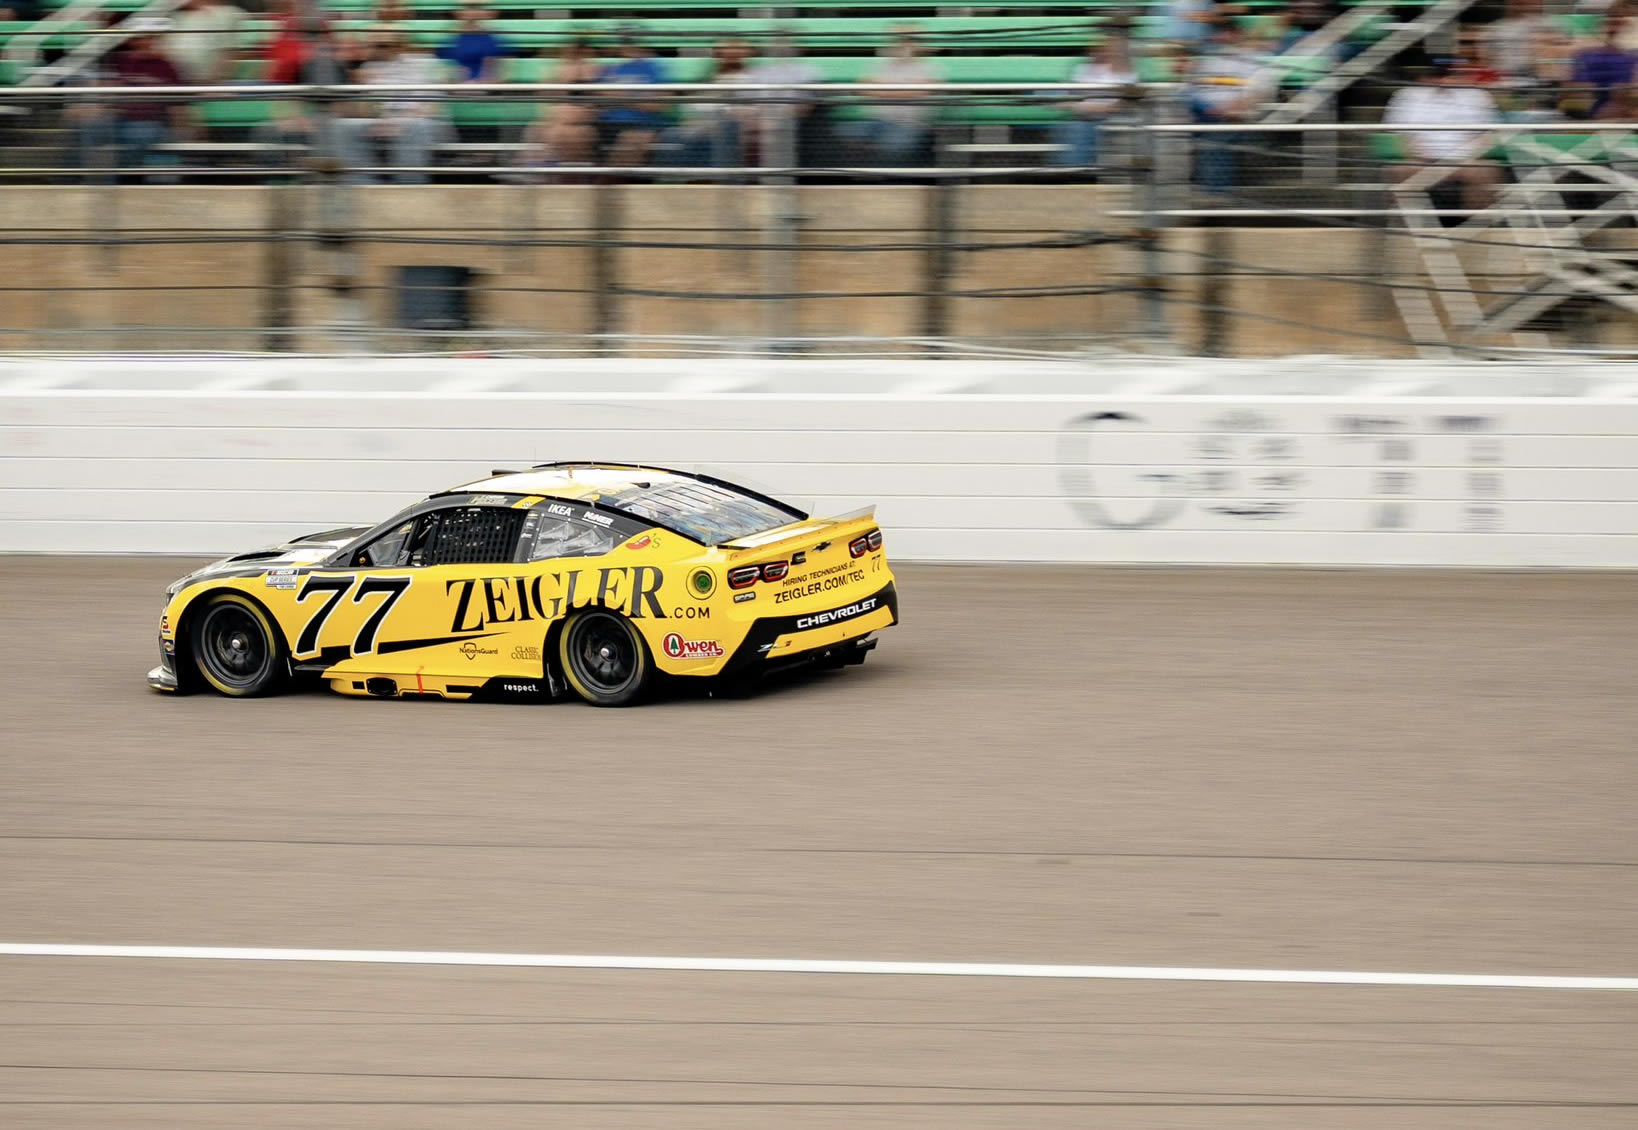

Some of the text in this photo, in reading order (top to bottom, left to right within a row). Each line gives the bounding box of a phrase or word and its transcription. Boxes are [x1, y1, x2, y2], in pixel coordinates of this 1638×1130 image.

[547, 504, 572, 516] IKEA
[872, 554, 881, 573] 77
[782, 574, 808, 588] HIRING
[809, 562, 848, 580] TECHNICIANS
[296, 574, 413, 656] 77
[797, 598, 877, 629] CHEVROLET
[459, 647, 499, 655] NationsGuard
[663, 633, 724, 657] Owen
[503, 684, 540, 693] respect.
